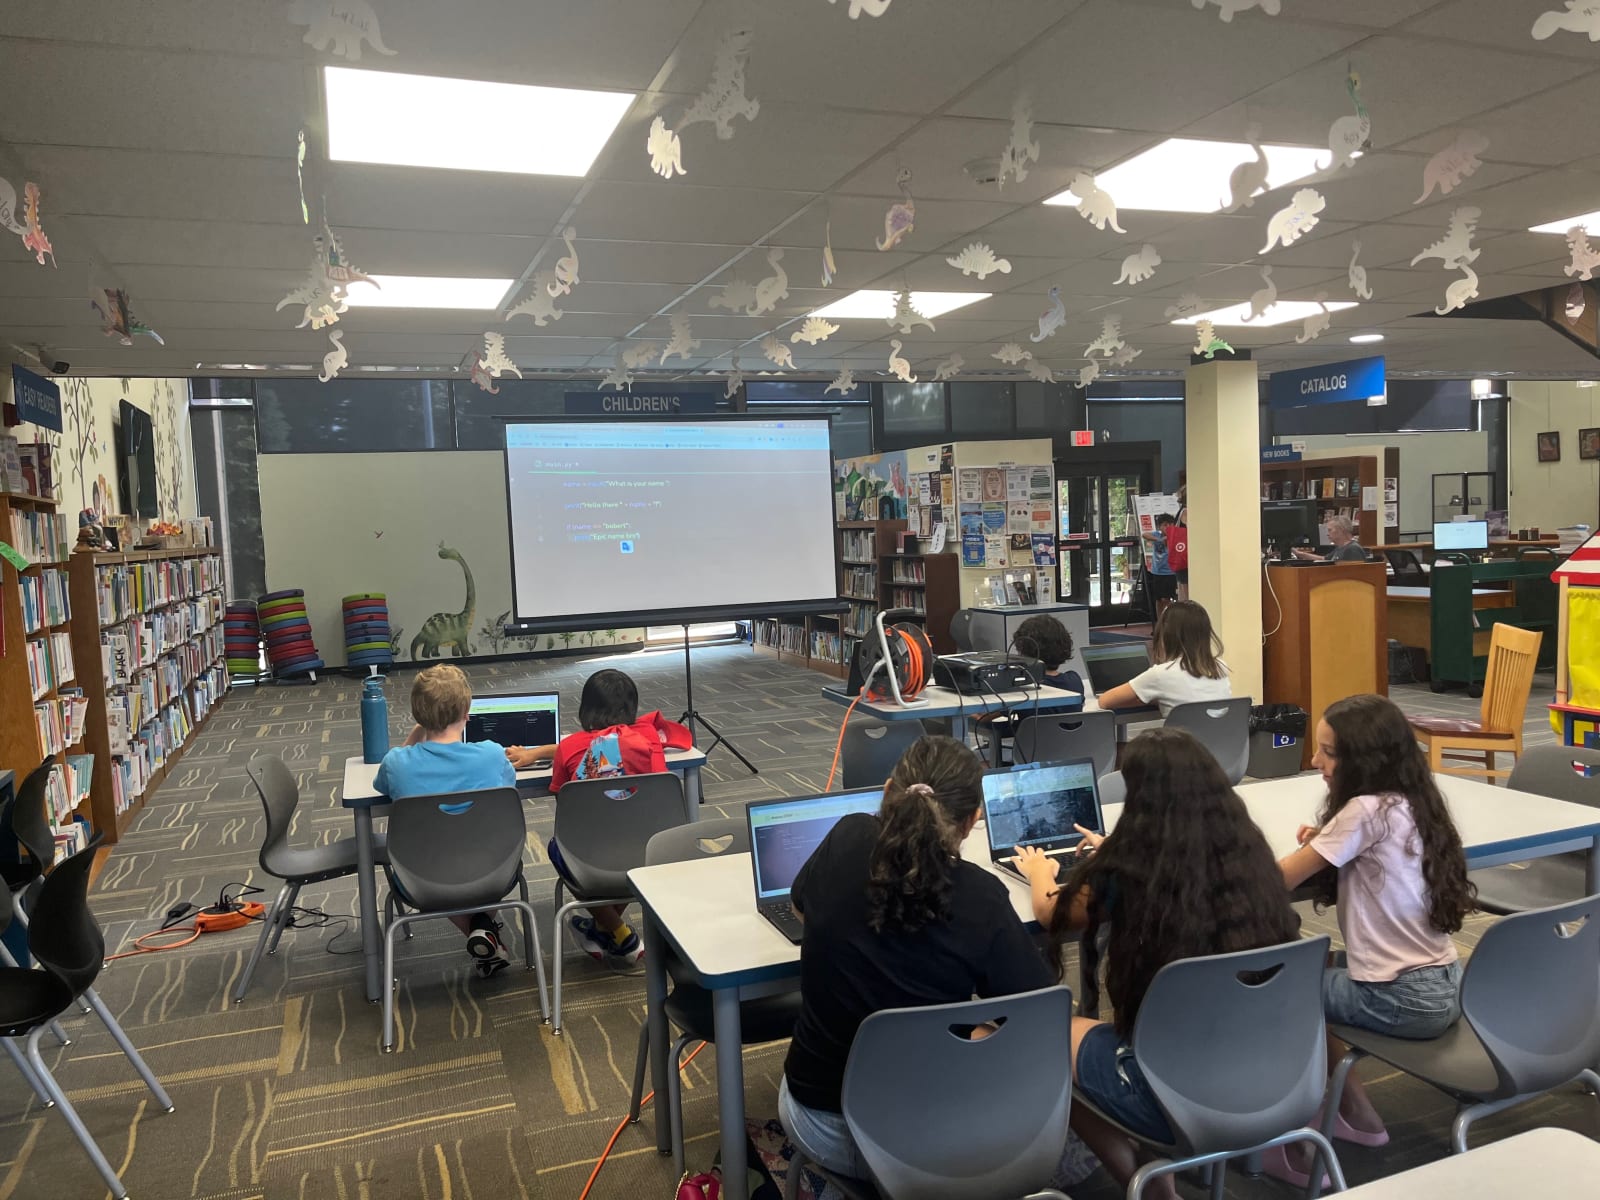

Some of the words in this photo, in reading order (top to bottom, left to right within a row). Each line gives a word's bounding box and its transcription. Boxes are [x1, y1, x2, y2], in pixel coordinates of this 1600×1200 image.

[1300, 374, 1347, 395] CATALOG
[602, 396, 681, 412] CHILDREN'S
[1274, 450, 1290, 458] BOOKS
[115, 647, 127, 679] BLACK
